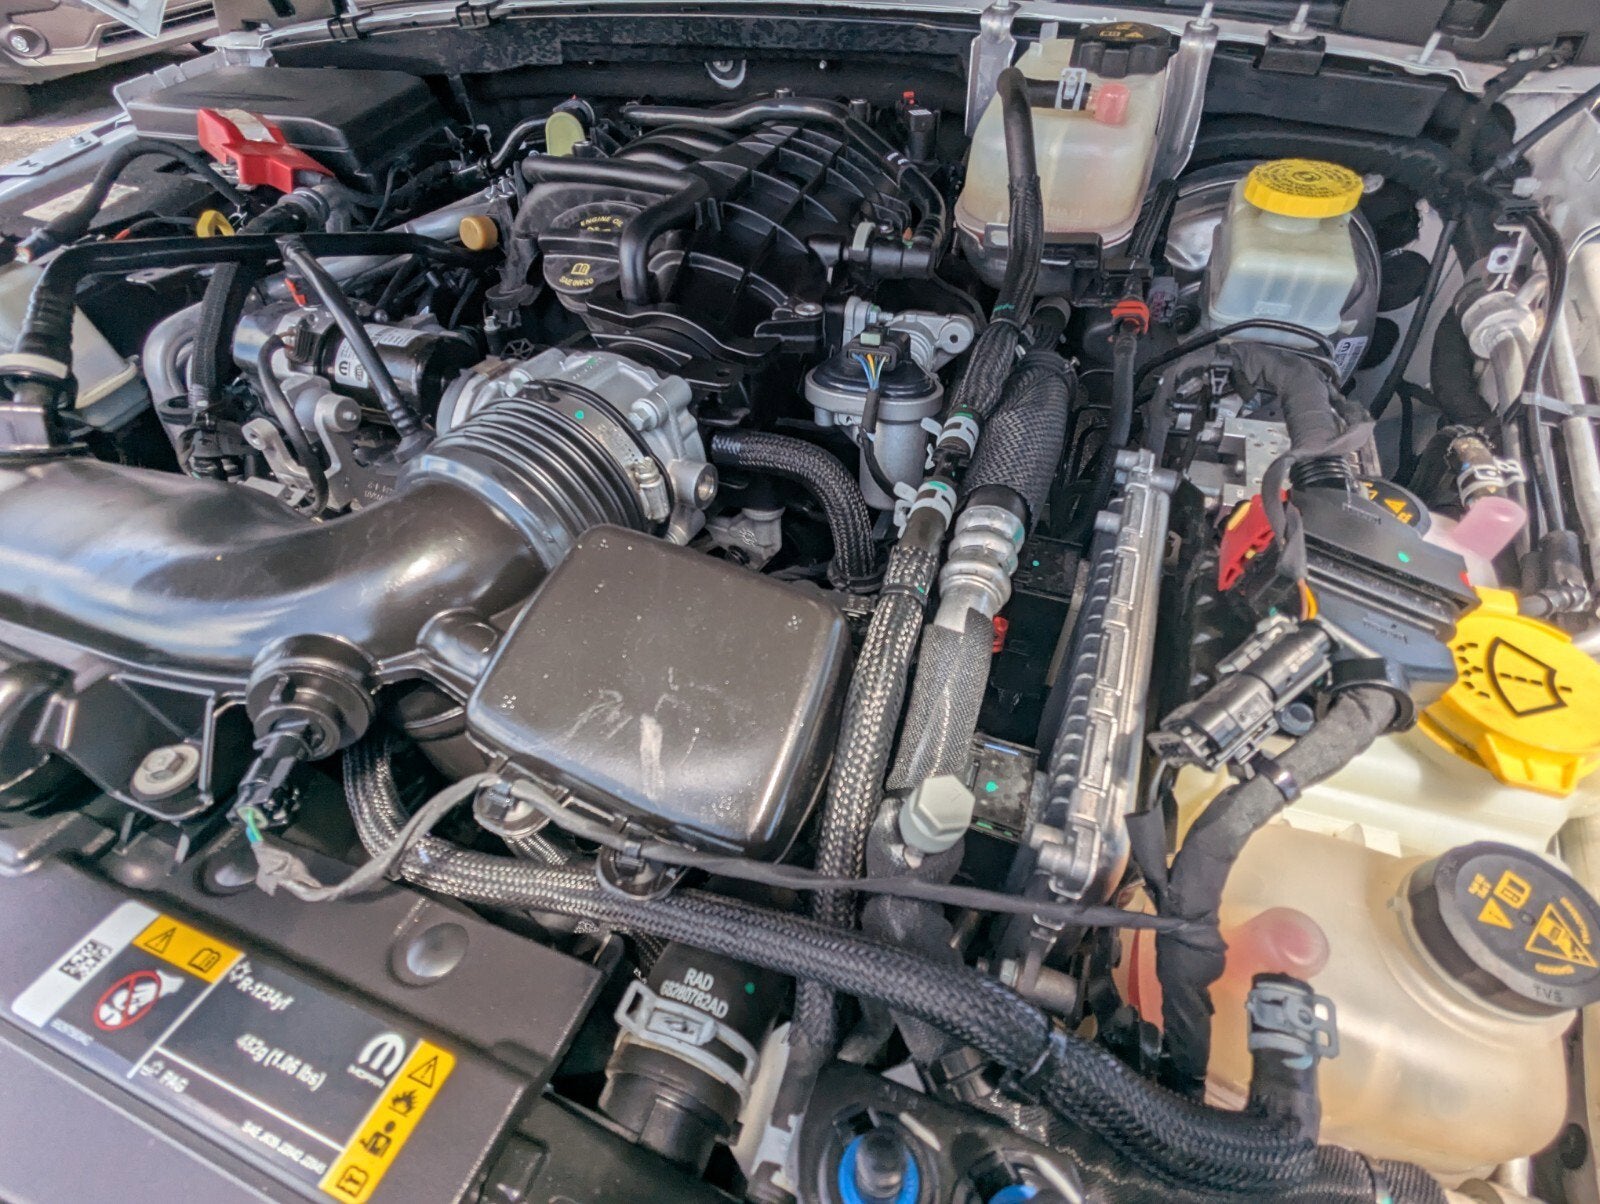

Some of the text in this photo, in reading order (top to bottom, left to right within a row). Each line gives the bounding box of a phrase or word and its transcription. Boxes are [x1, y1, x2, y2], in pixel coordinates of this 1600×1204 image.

[580, 216, 611, 227] ENGINE
[683, 967, 715, 992] RAD
[236, 976, 295, 1011] R-1234yf
[158, 1069, 190, 1093] PAG
[295, 1063, 328, 1092] lbs)
